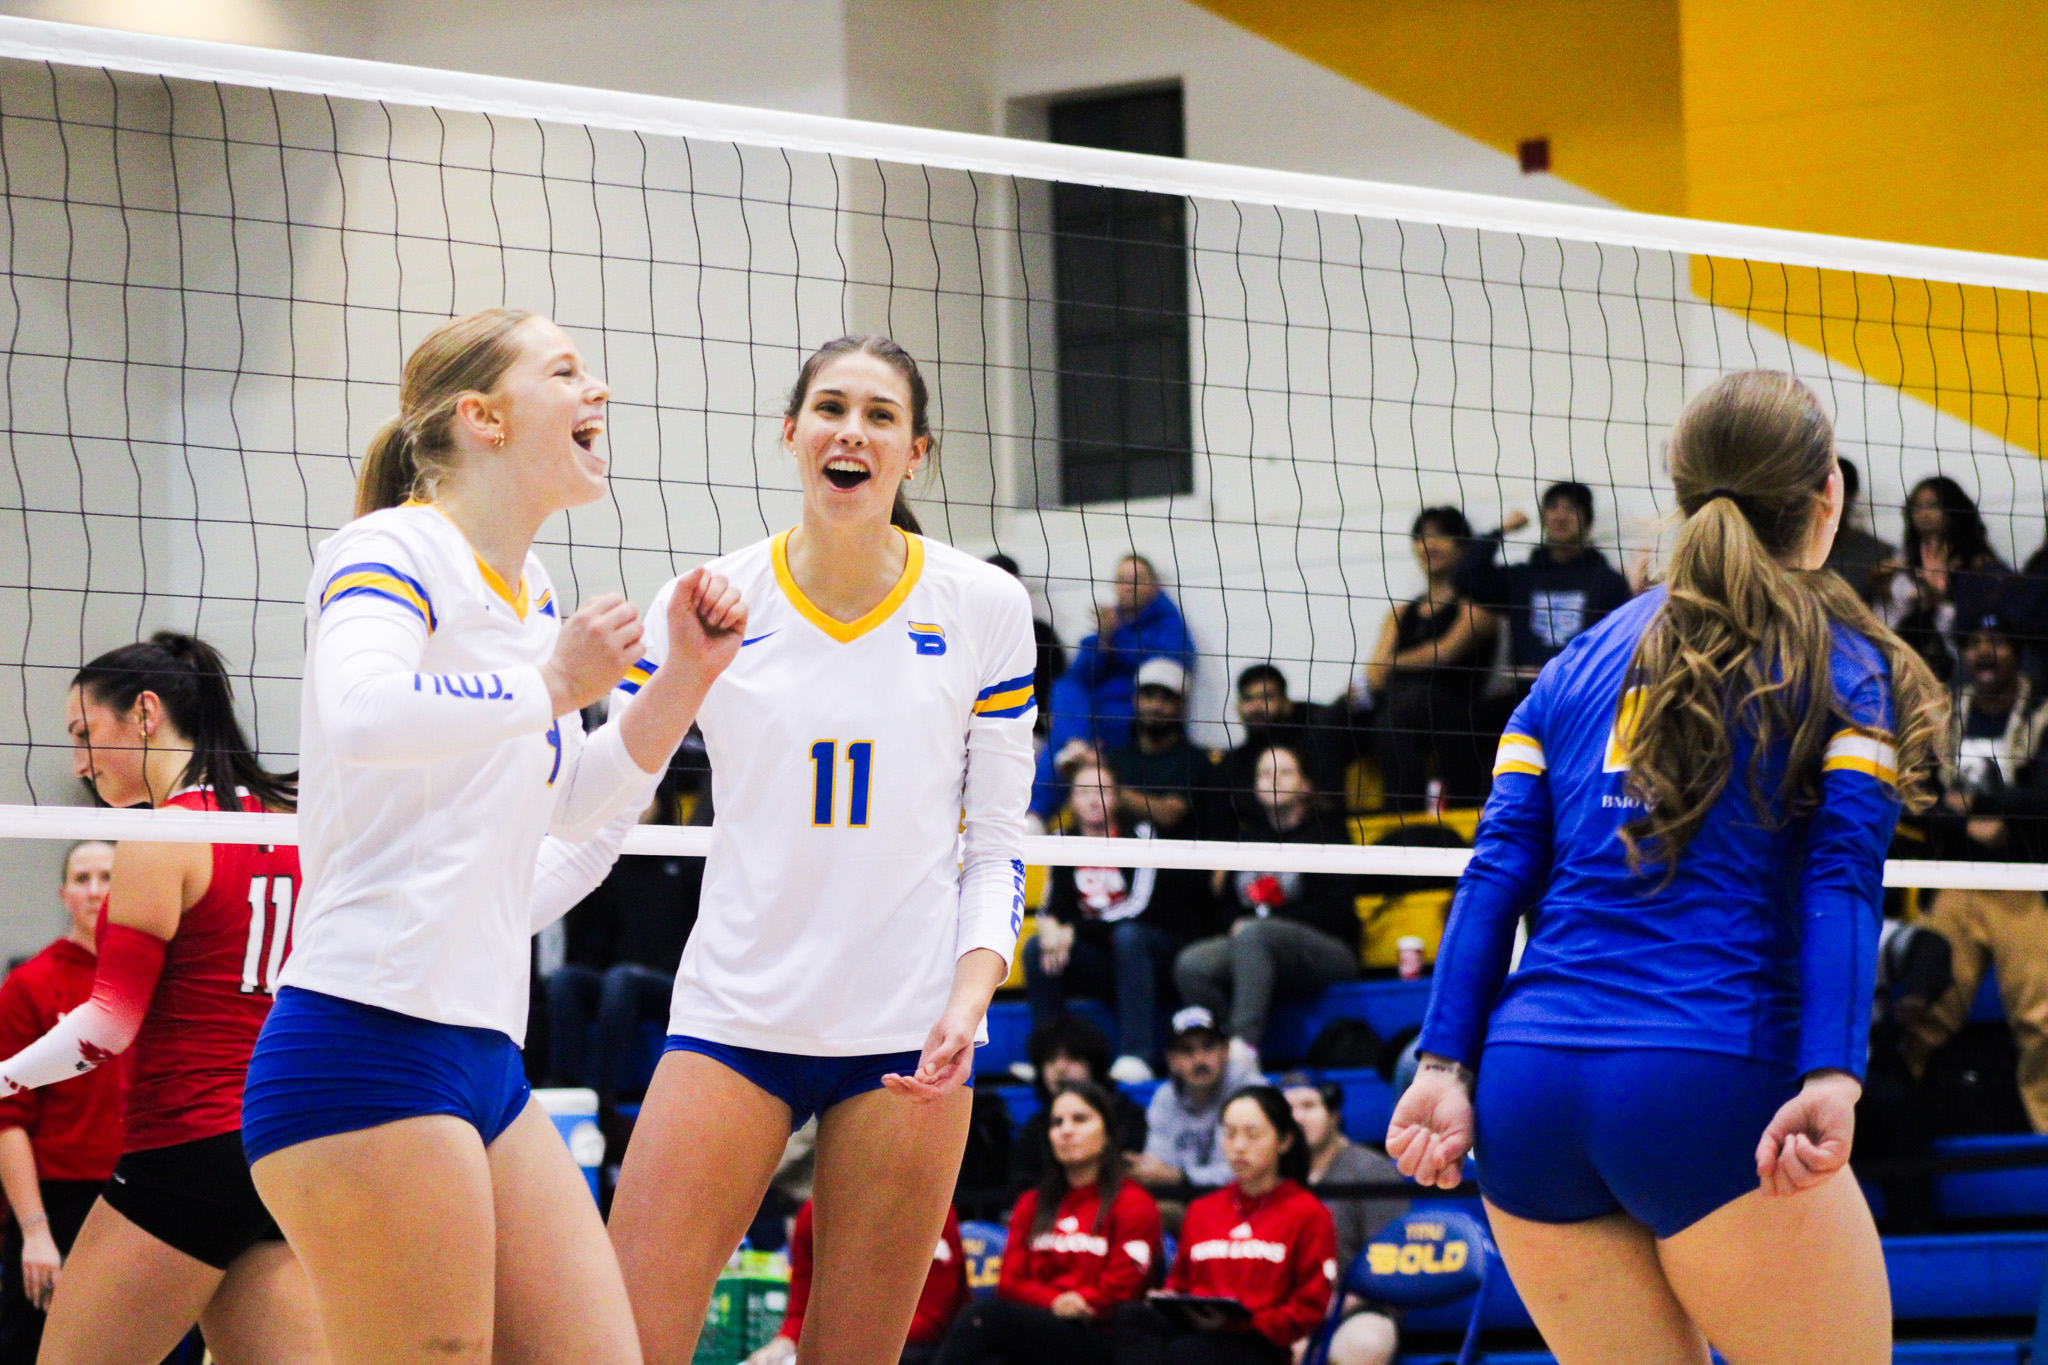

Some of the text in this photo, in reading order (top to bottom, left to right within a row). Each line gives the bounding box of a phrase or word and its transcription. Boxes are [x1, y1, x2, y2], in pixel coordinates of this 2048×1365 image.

[808, 738, 875, 828] 11
[1602, 795, 1641, 809] BMO
[240, 875, 294, 996] 11
[1366, 1240, 1468, 1275] BOLD
